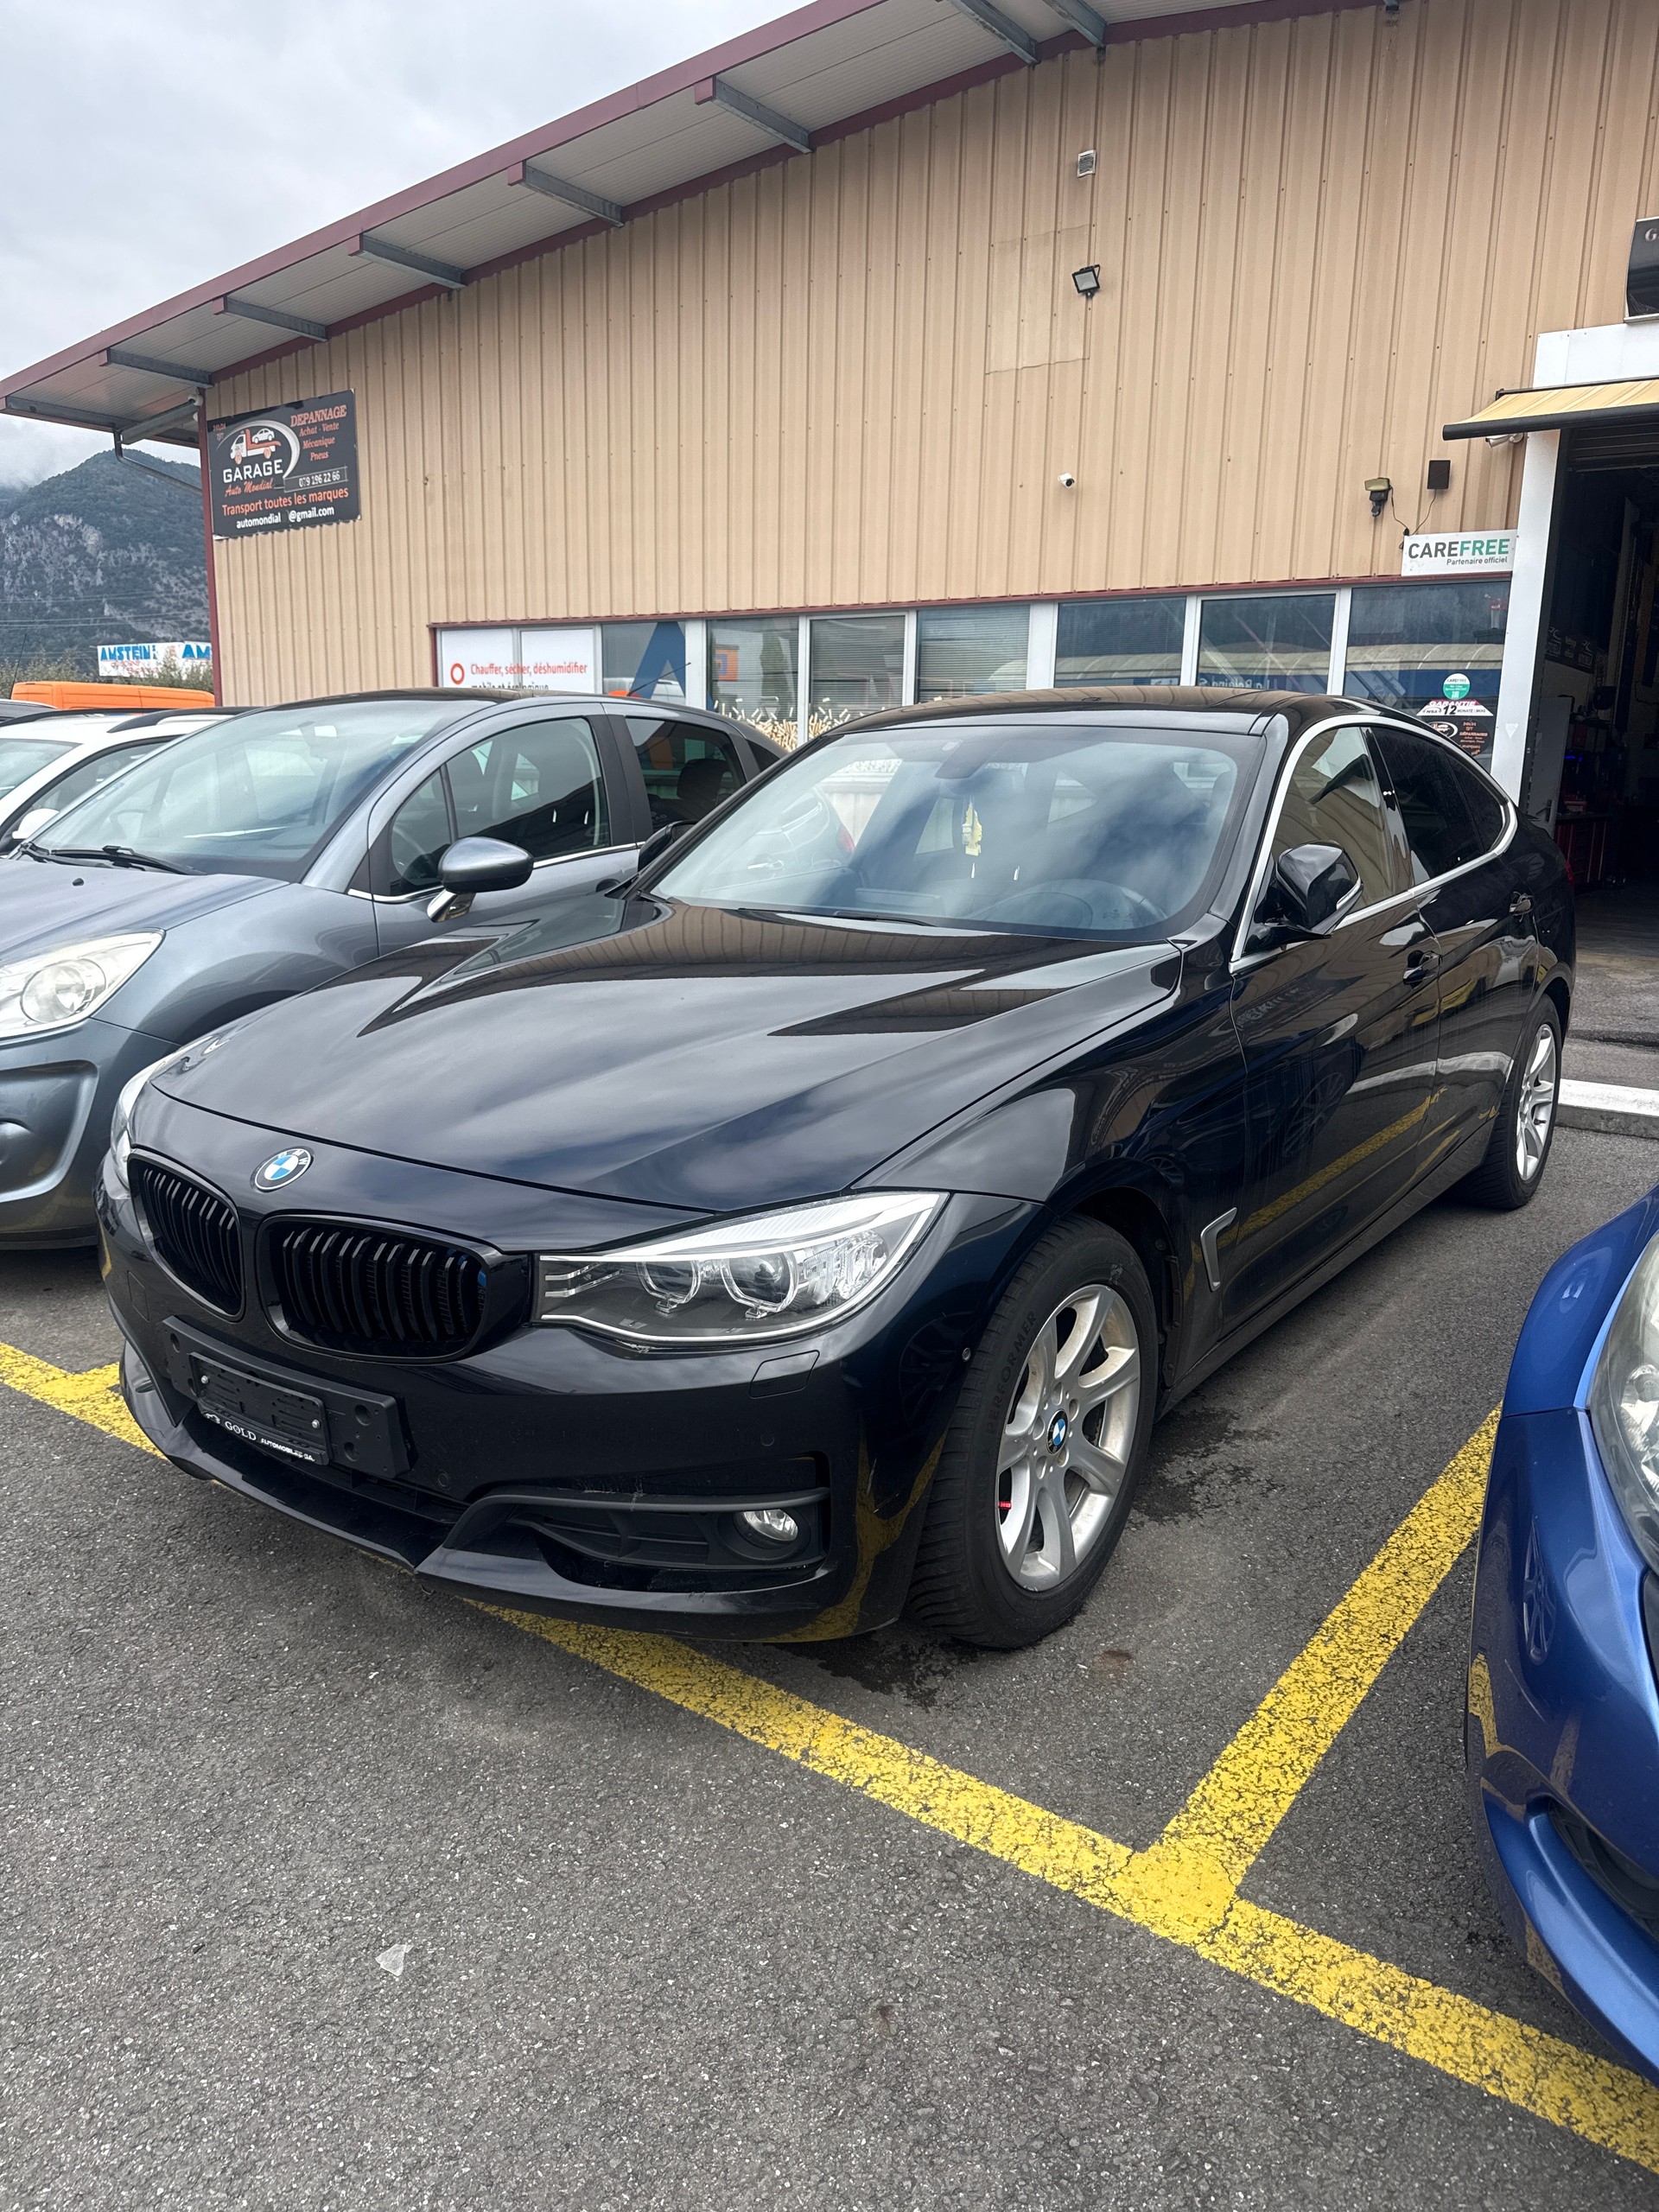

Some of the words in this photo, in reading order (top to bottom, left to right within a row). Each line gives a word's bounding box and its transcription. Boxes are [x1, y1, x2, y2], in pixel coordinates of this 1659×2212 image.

[290, 404, 347, 428] DEPANNAGE
[299, 426, 317, 436] Achat
[322, 423, 340, 431] Vente
[303, 436, 335, 449] Mécanique
[310, 451, 329, 461] Pneus
[223, 459, 283, 483] GARAGE
[323, 472, 332, 483] 22
[225, 484, 242, 498] Auto
[244, 477, 274, 493] Mondial
[222, 499, 263, 516] Transport
[264, 496, 292, 510] toutes
[294, 492, 307, 505] les
[308, 487, 349, 503] marques
[236, 512, 282, 529] automondial
[289, 506, 335, 523] @gmail.com
[1408, 538, 1510, 559] CAREFREE
[1446, 557, 1484, 566] Partenaire
[1484, 556, 1508, 564] officiel
[100, 645, 151, 661] AMSTEIN
[471, 663, 504, 677] Chauffer,
[505, 662, 532, 677] sécher,
[533, 661, 588, 675] déshumidifier
[1443, 705, 1458, 715] 12
[986, 1310, 1037, 1434] PERFORMER
[225, 1421, 257, 1441] GOLD
[261, 1438, 303, 1459] AUTOMOBILES
